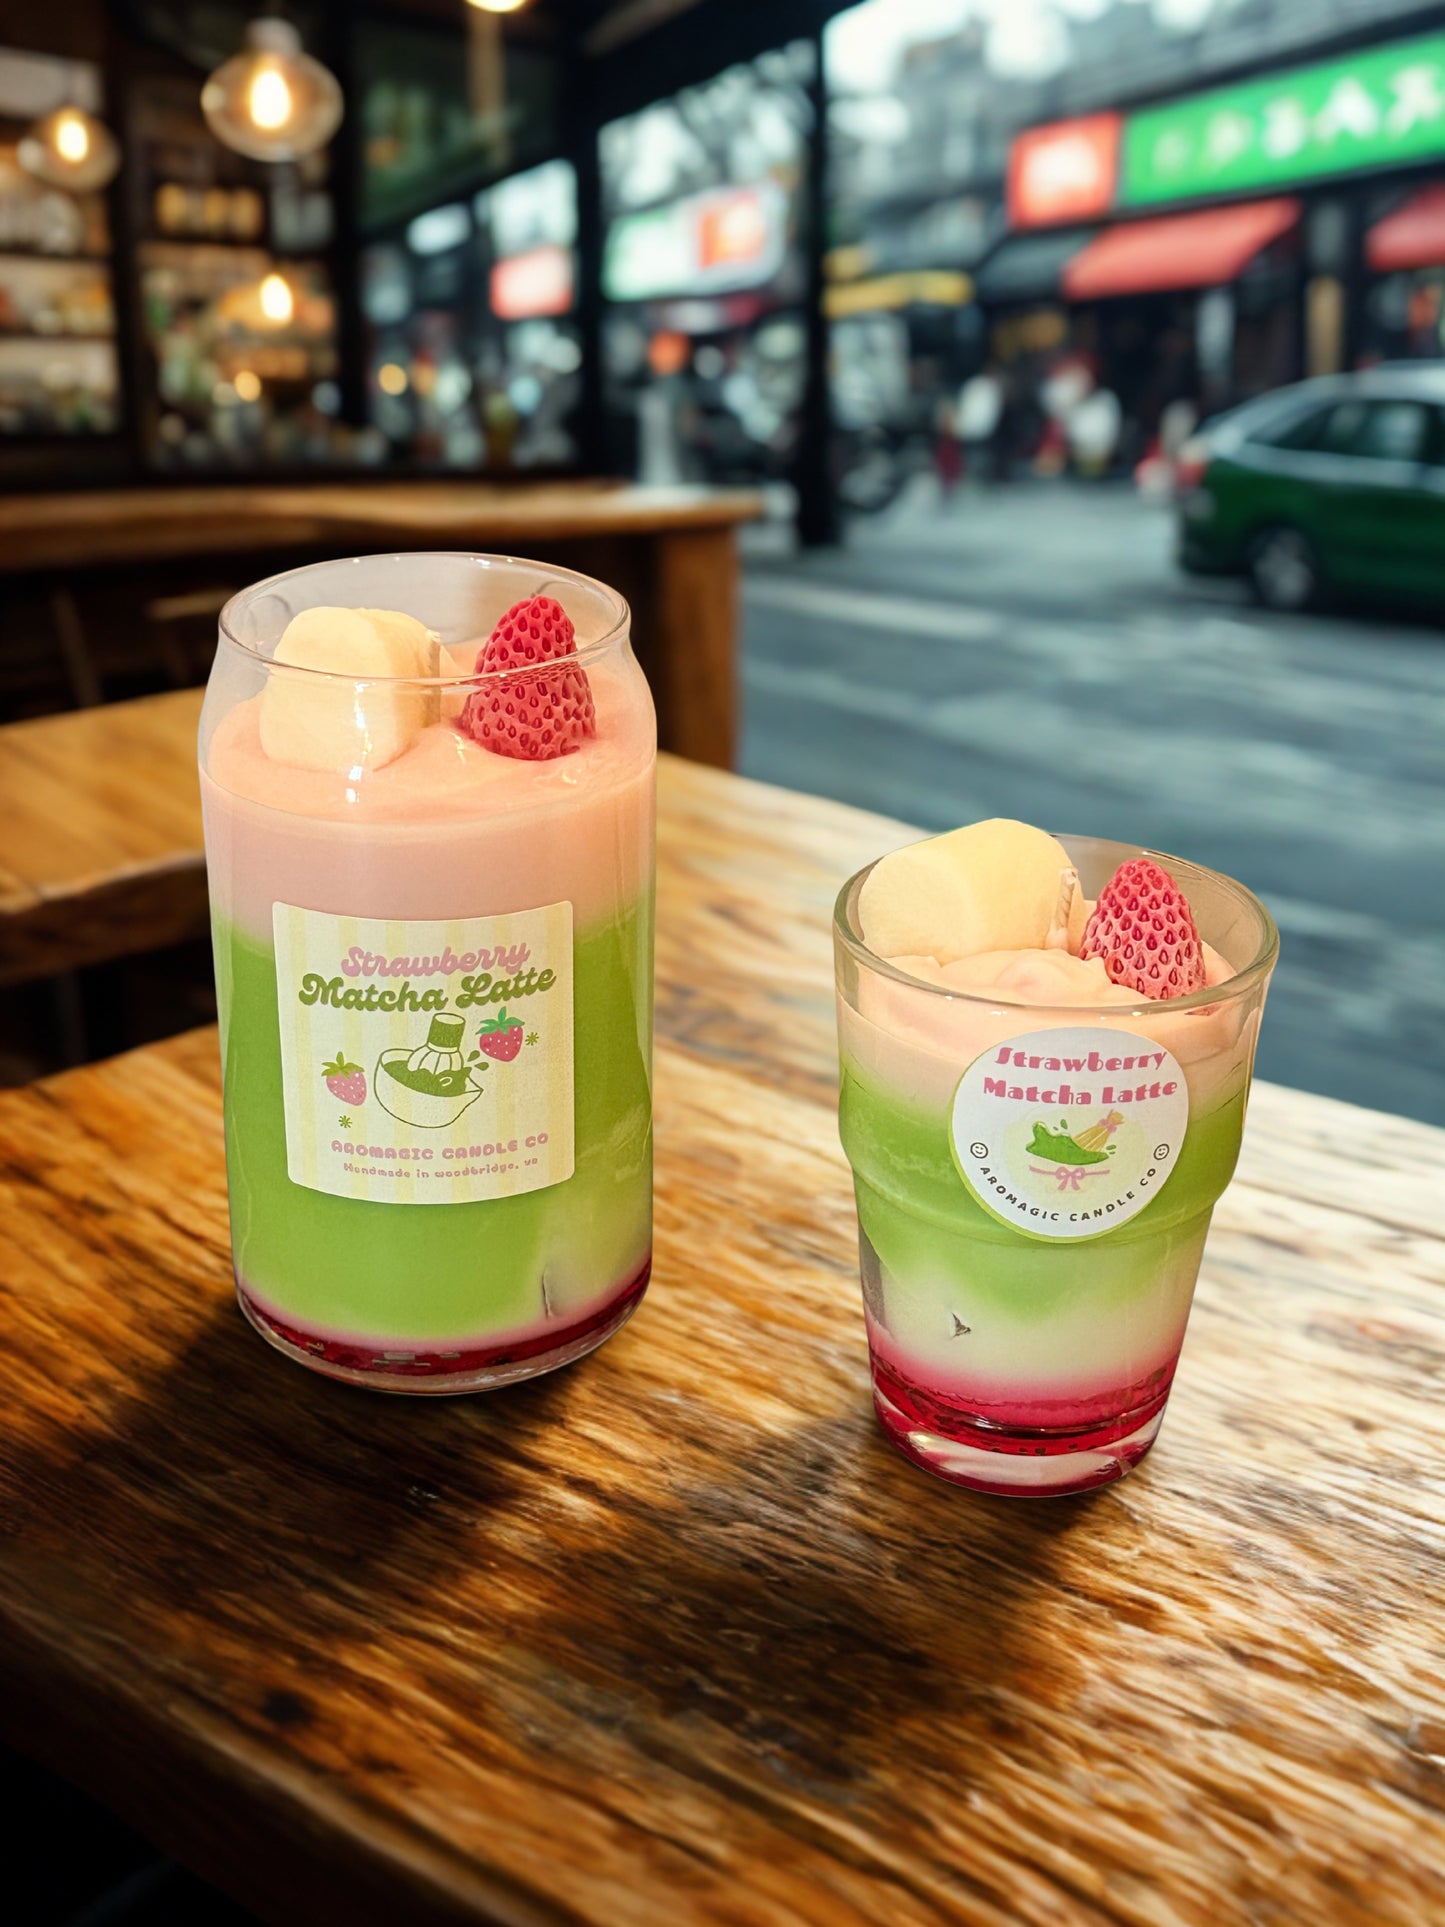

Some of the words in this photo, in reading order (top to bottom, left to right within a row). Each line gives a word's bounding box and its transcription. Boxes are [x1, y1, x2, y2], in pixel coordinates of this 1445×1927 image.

[341, 943, 530, 977] Strawberry
[299, 973, 448, 1011] Matcha
[455, 968, 556, 1008] Latte
[995, 1047, 1167, 1072] Strawberry
[984, 1077, 1091, 1105] Matcha
[1102, 1081, 1178, 1104] Latte
[331, 1140, 434, 1160] AROMAGIC
[442, 1139, 518, 1159] CANDLE
[525, 1133, 549, 1148] CO
[417, 1168, 430, 1178] in
[980, 1166, 1059, 1221] AROMAGIC
[1069, 1191, 1135, 1222] CANDLE
[1139, 1168, 1156, 1186] CO
